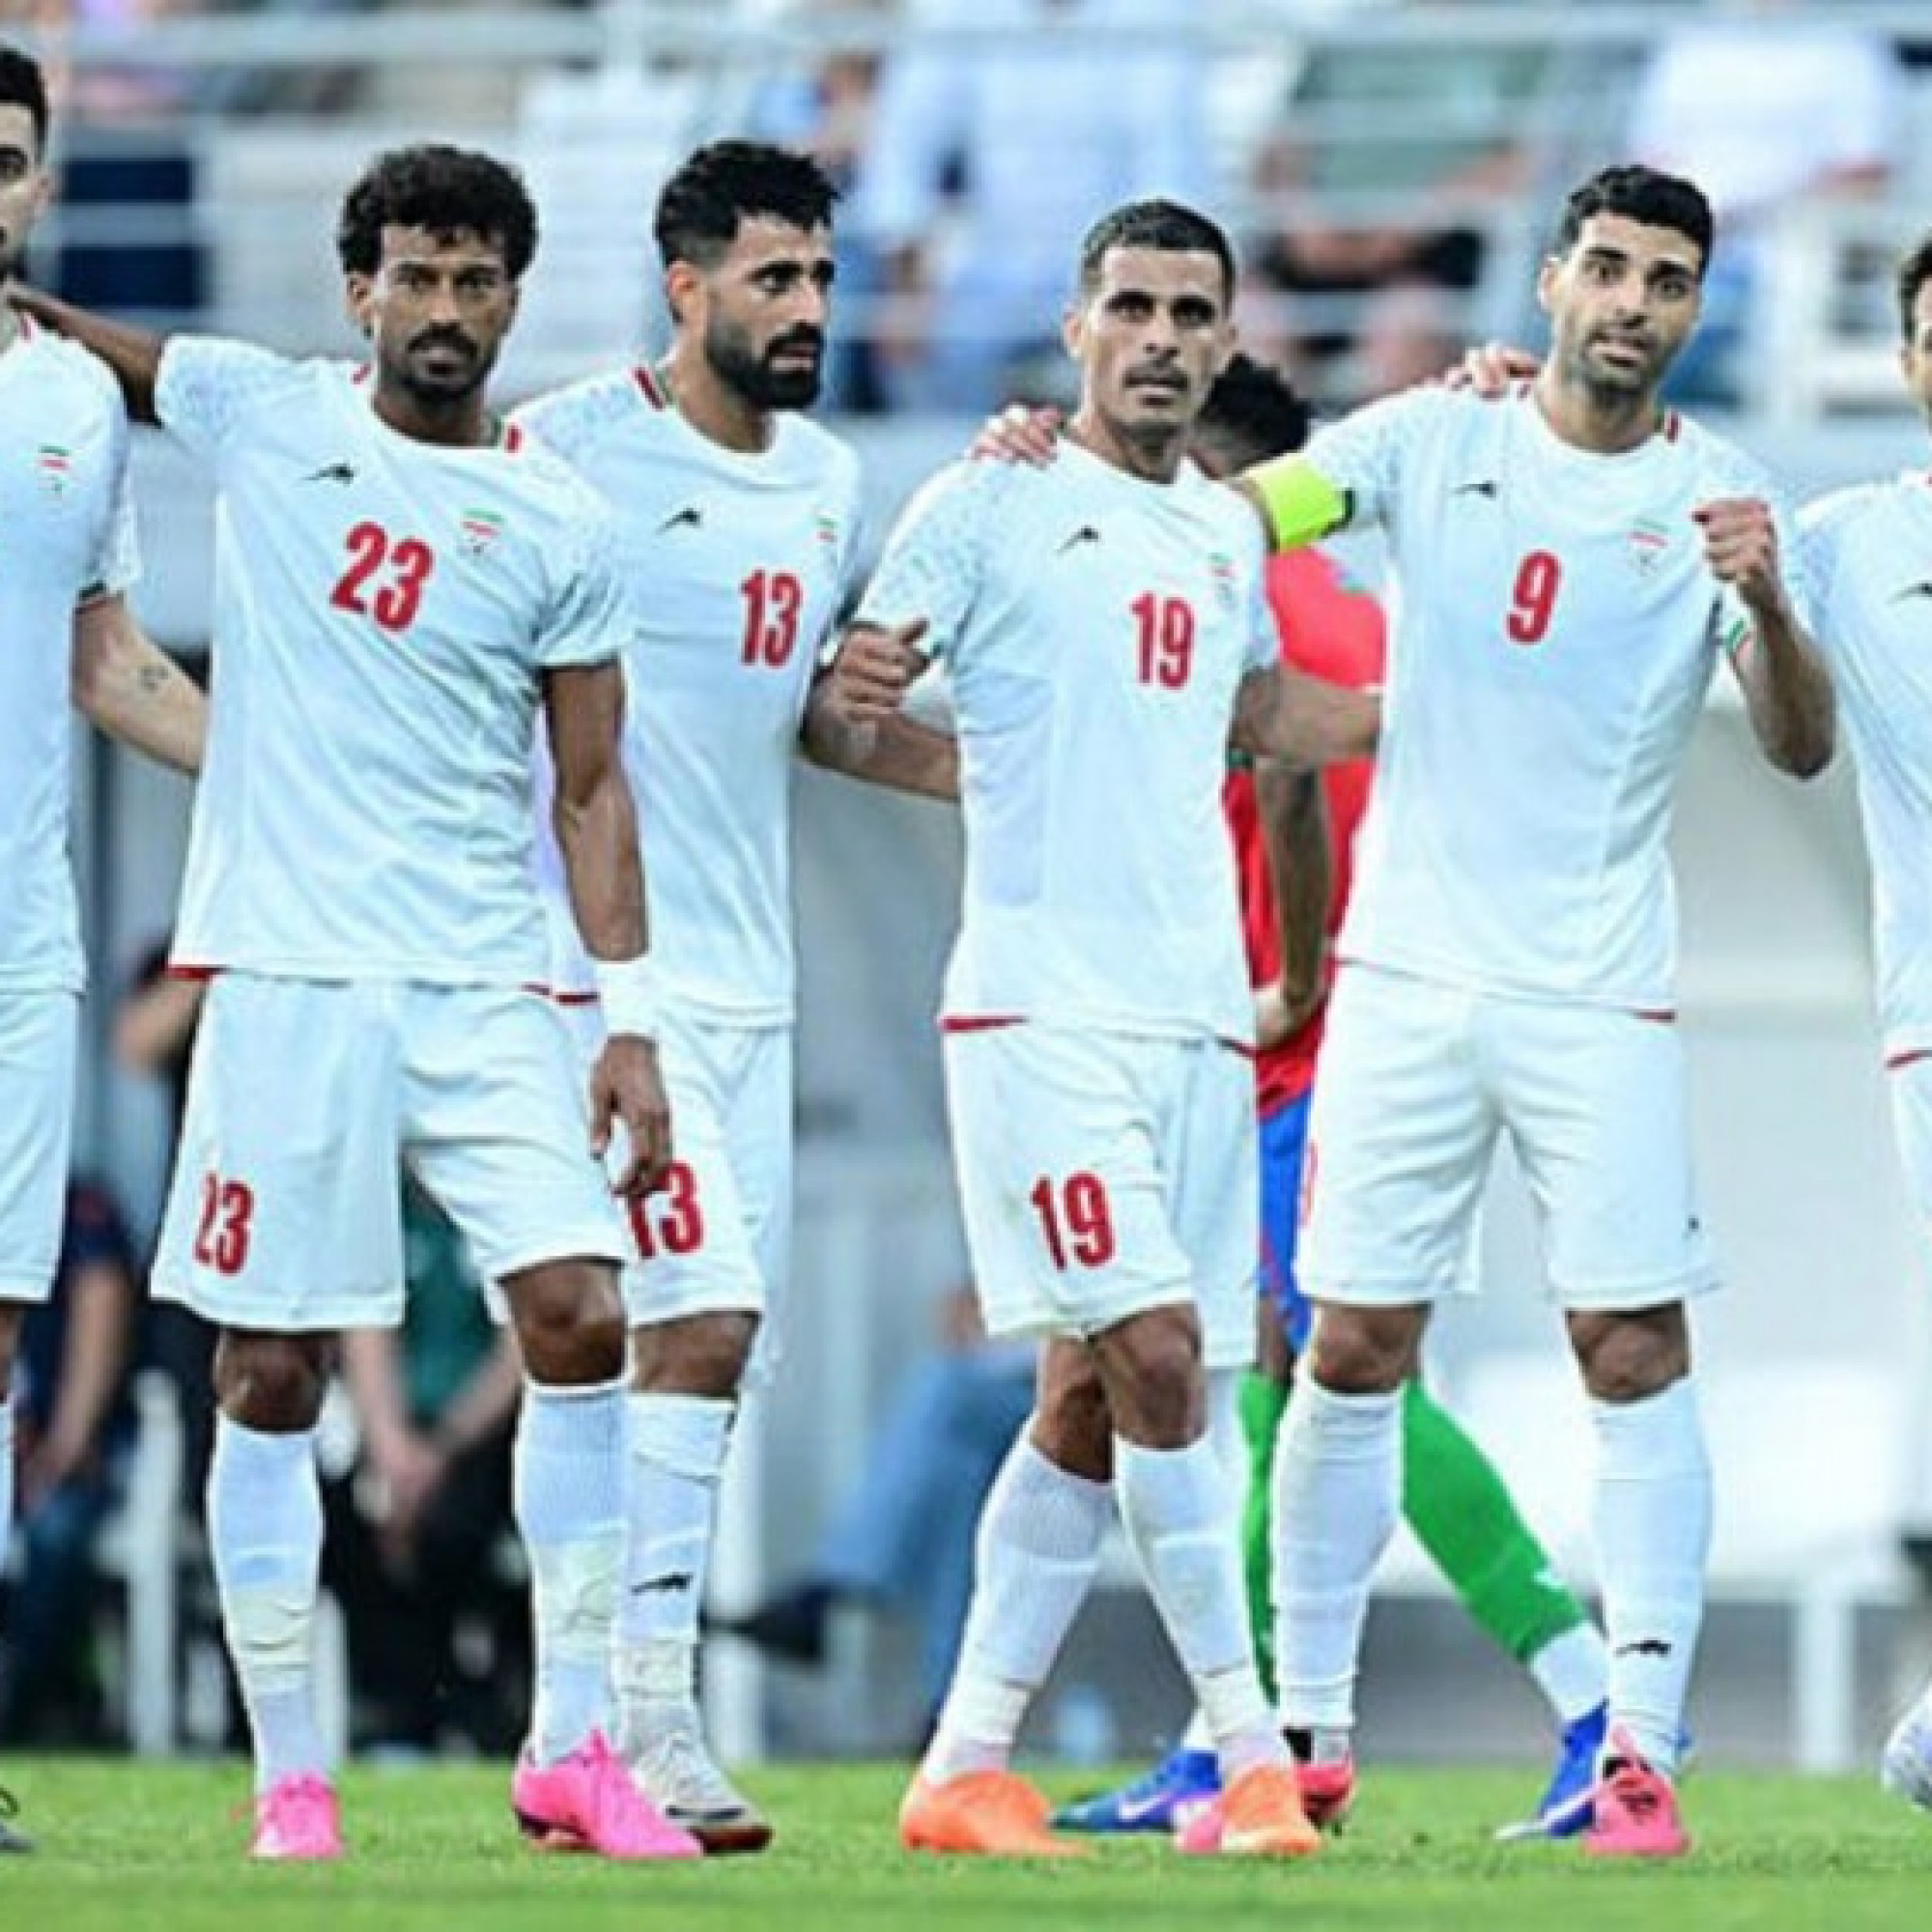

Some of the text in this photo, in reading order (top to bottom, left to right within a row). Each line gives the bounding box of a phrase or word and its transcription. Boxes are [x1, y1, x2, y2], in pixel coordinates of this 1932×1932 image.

[331, 523, 434, 631] 23
[740, 570, 803, 668] 13
[1507, 551, 1561, 643] 9
[1131, 591, 1196, 689] 19
[626, 1161, 703, 1260] 13
[1031, 1171, 1115, 1267] 19
